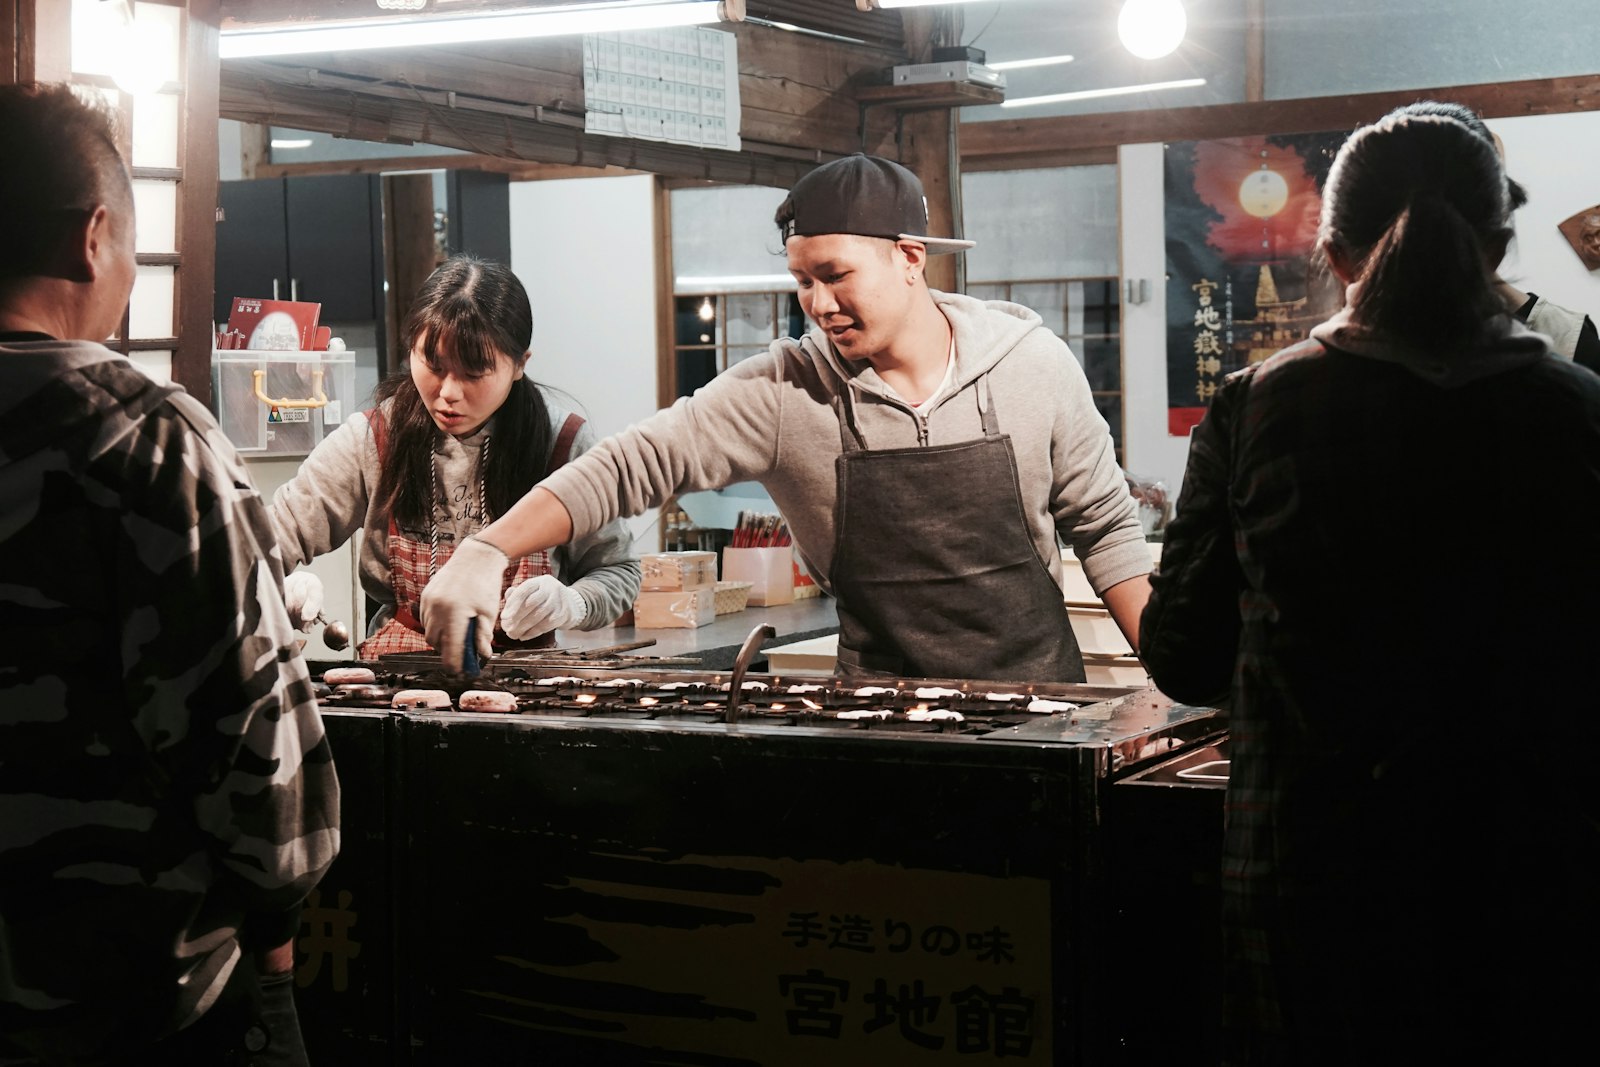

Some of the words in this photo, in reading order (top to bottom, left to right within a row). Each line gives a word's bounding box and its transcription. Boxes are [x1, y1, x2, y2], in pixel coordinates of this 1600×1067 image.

[783, 911, 1015, 964] 手造りの味
[778, 969, 1036, 1058] 宮地館
